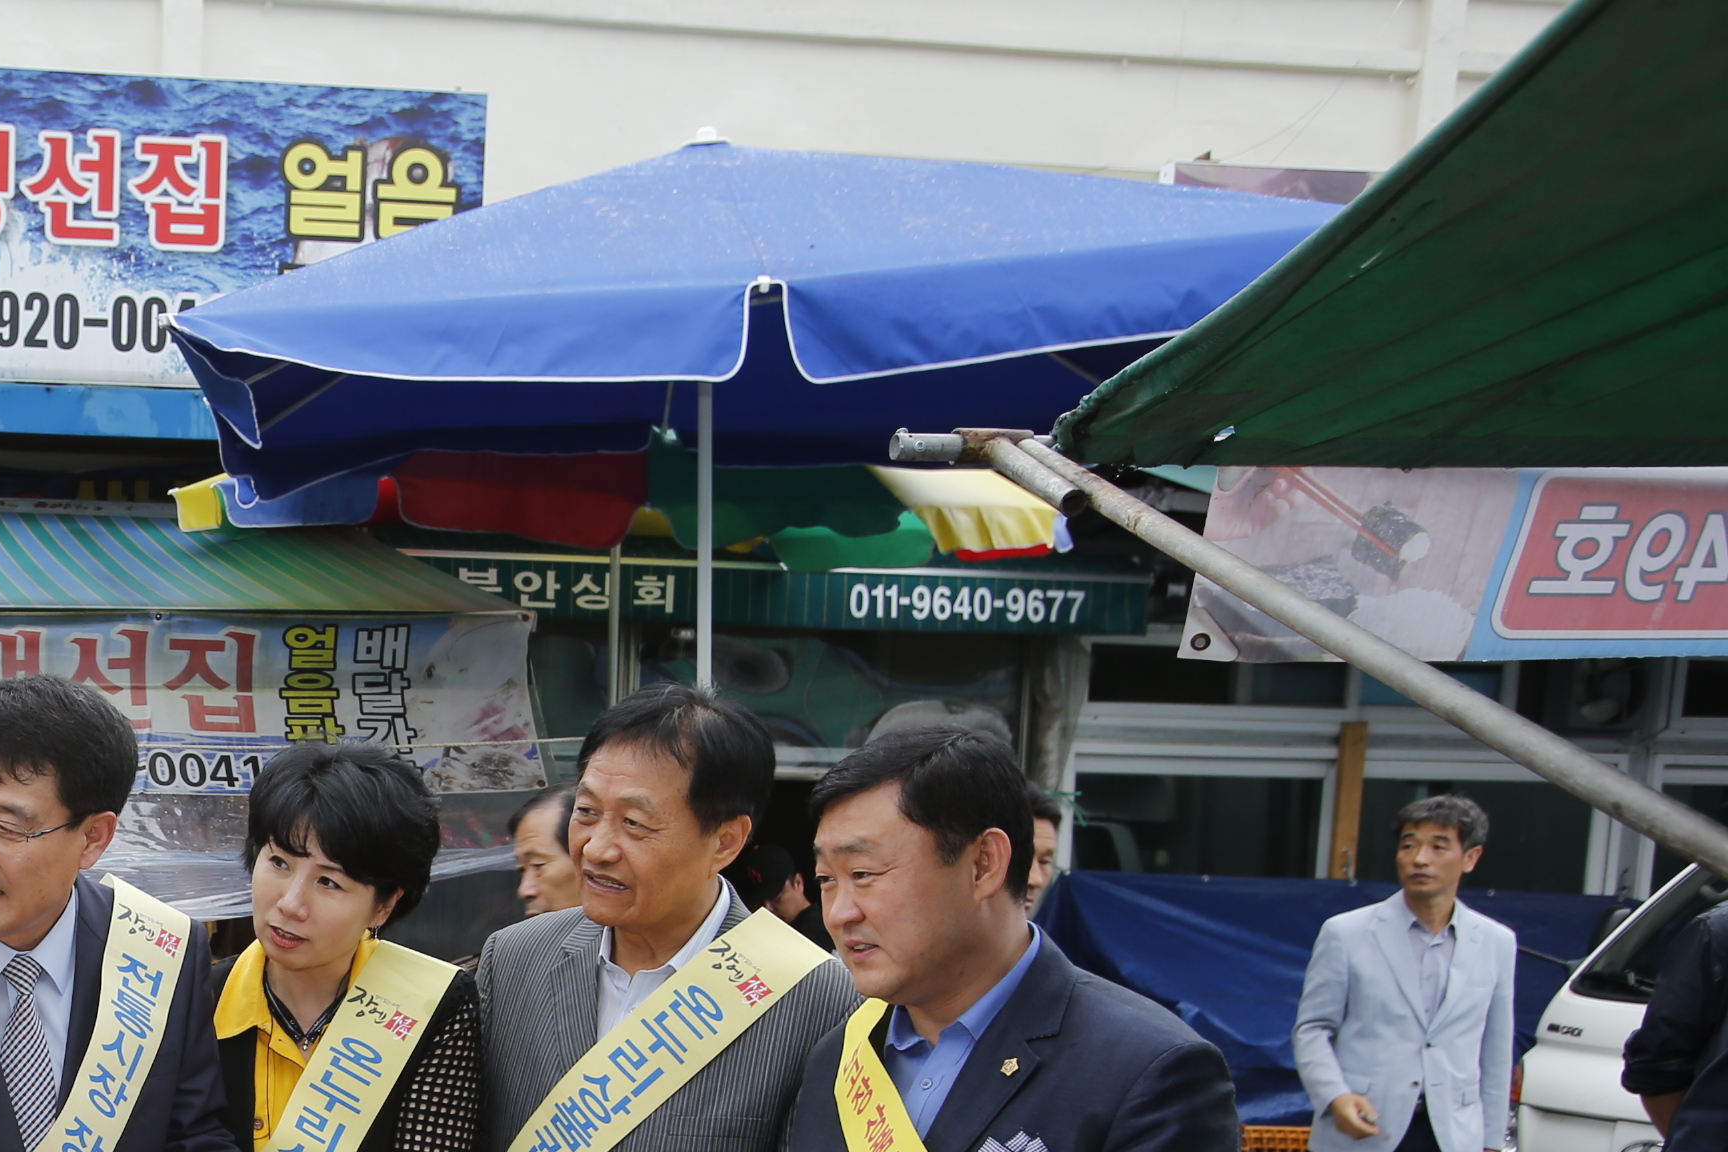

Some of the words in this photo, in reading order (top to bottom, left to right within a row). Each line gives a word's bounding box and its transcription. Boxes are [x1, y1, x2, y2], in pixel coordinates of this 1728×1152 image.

[278, 137, 462, 243] 얼음
[850, 583, 1085, 624] 011-9640-9677
[88, 952, 164, 1120] 전통시장
